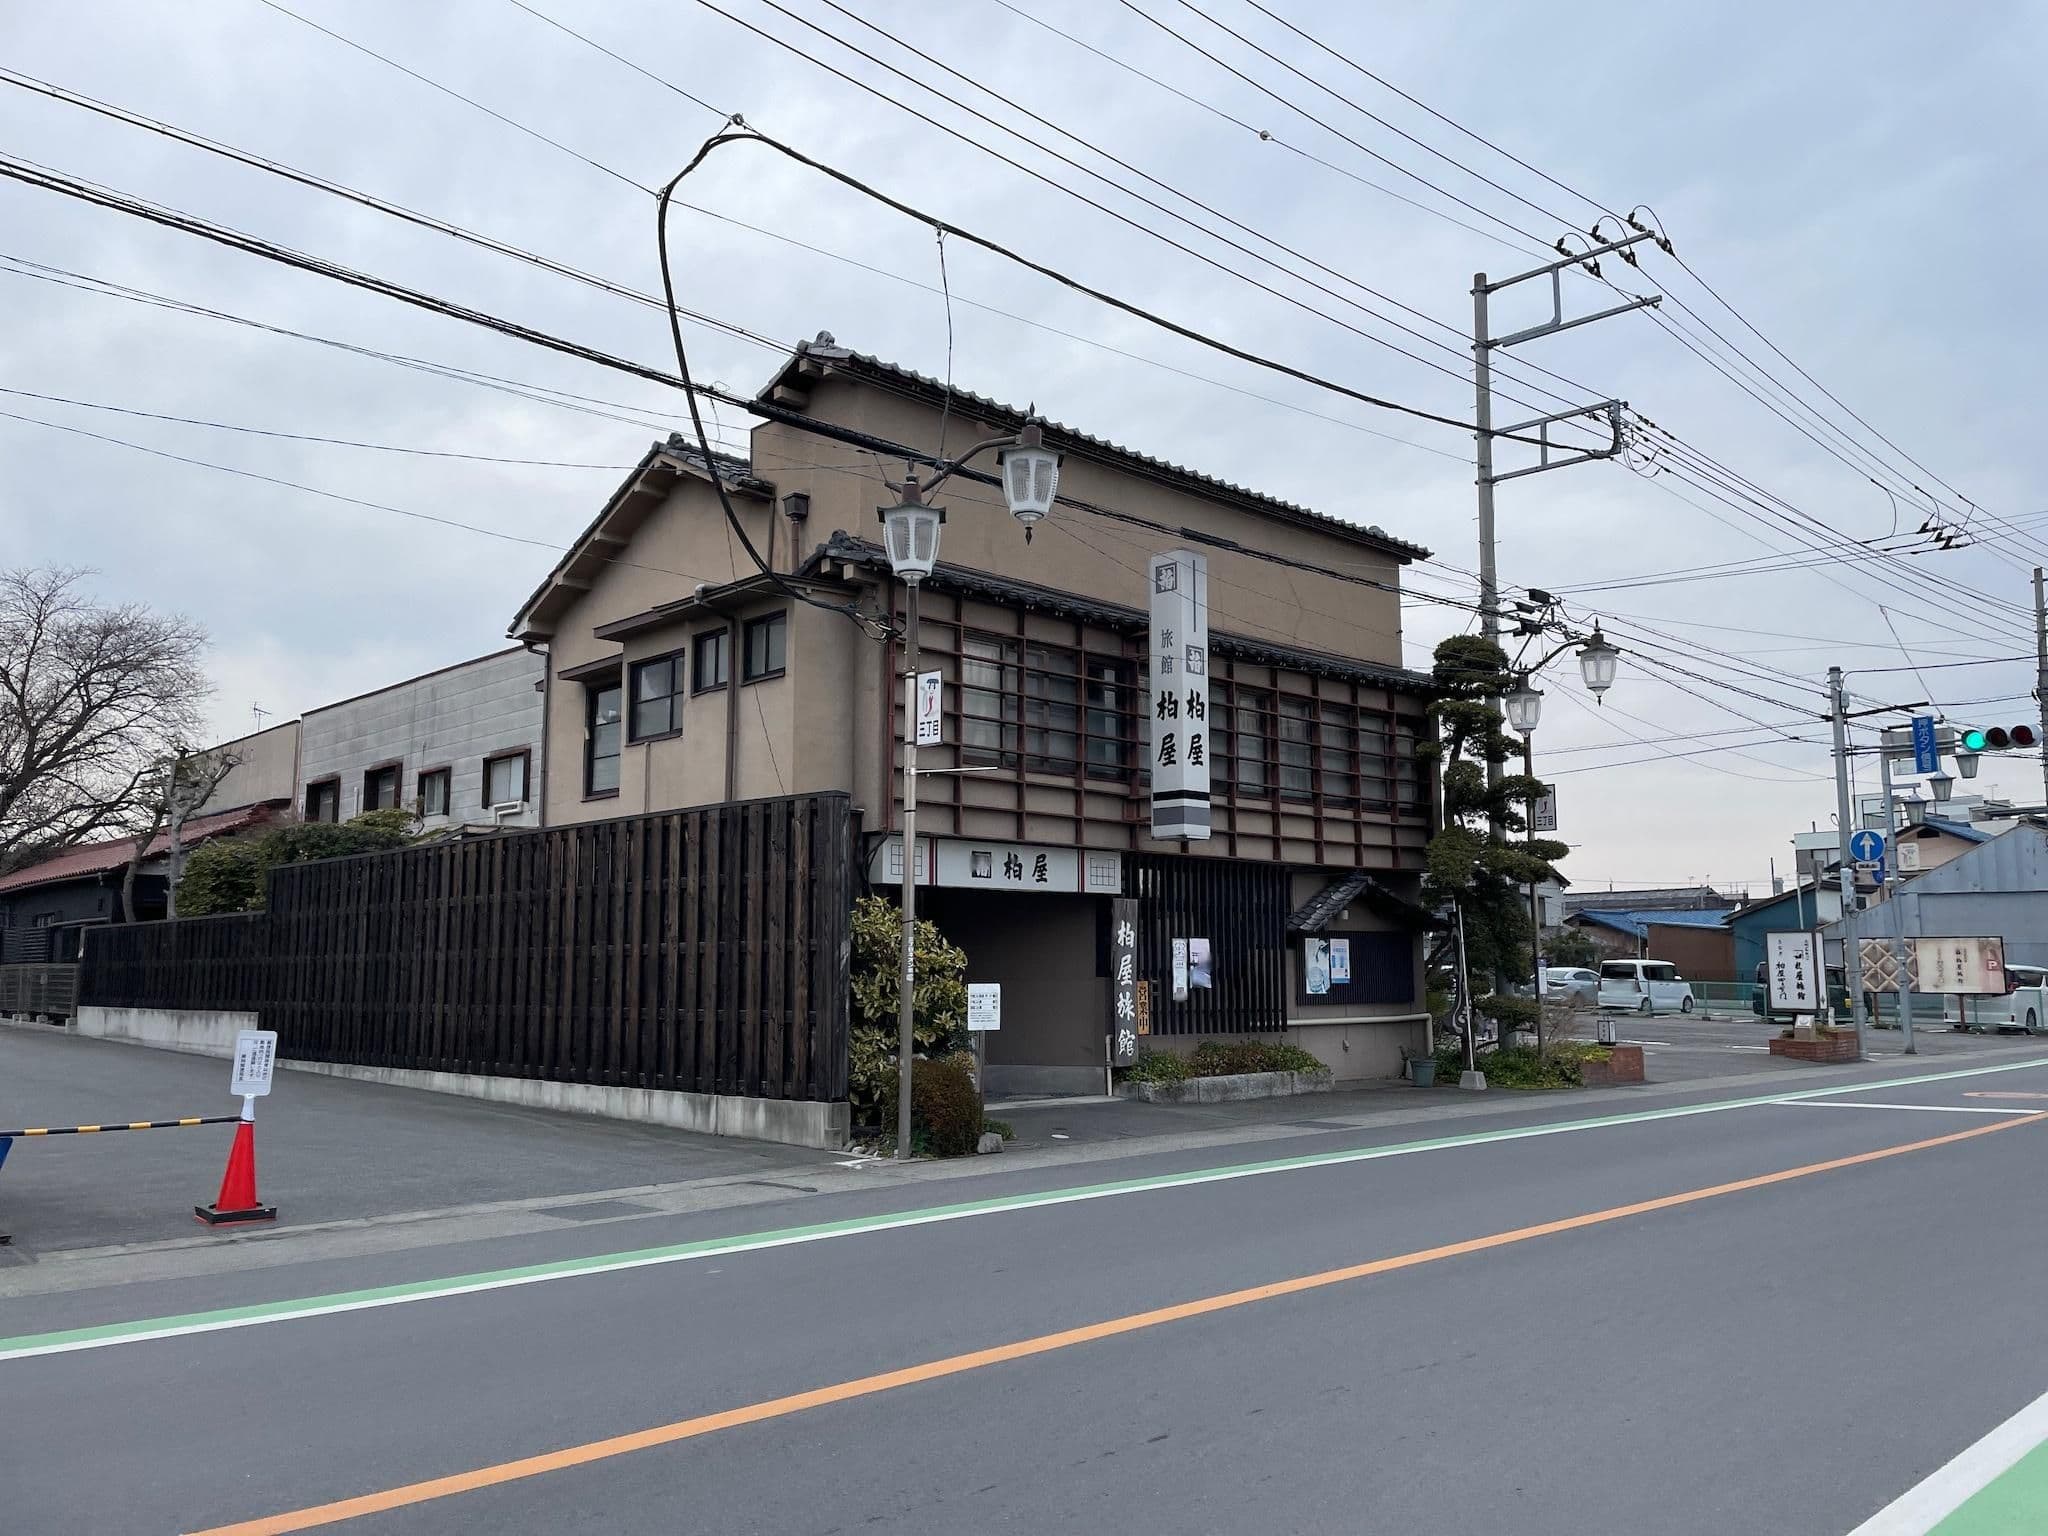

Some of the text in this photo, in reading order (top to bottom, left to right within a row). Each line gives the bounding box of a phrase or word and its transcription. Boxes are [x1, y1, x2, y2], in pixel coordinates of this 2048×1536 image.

[1156, 629, 1179, 767] 旅館 柏屋
[919, 719, 939, 737] 三丁目
[1187, 688, 1206, 767] 柏屋
[1536, 815, 1553, 826] 三丁目
[1003, 851, 1048, 883] 柏屋
[1987, 961, 1998, 969] P
[1117, 919, 1136, 1056] 柏屋旅館
[1138, 982, 1148, 1031] 営業中
